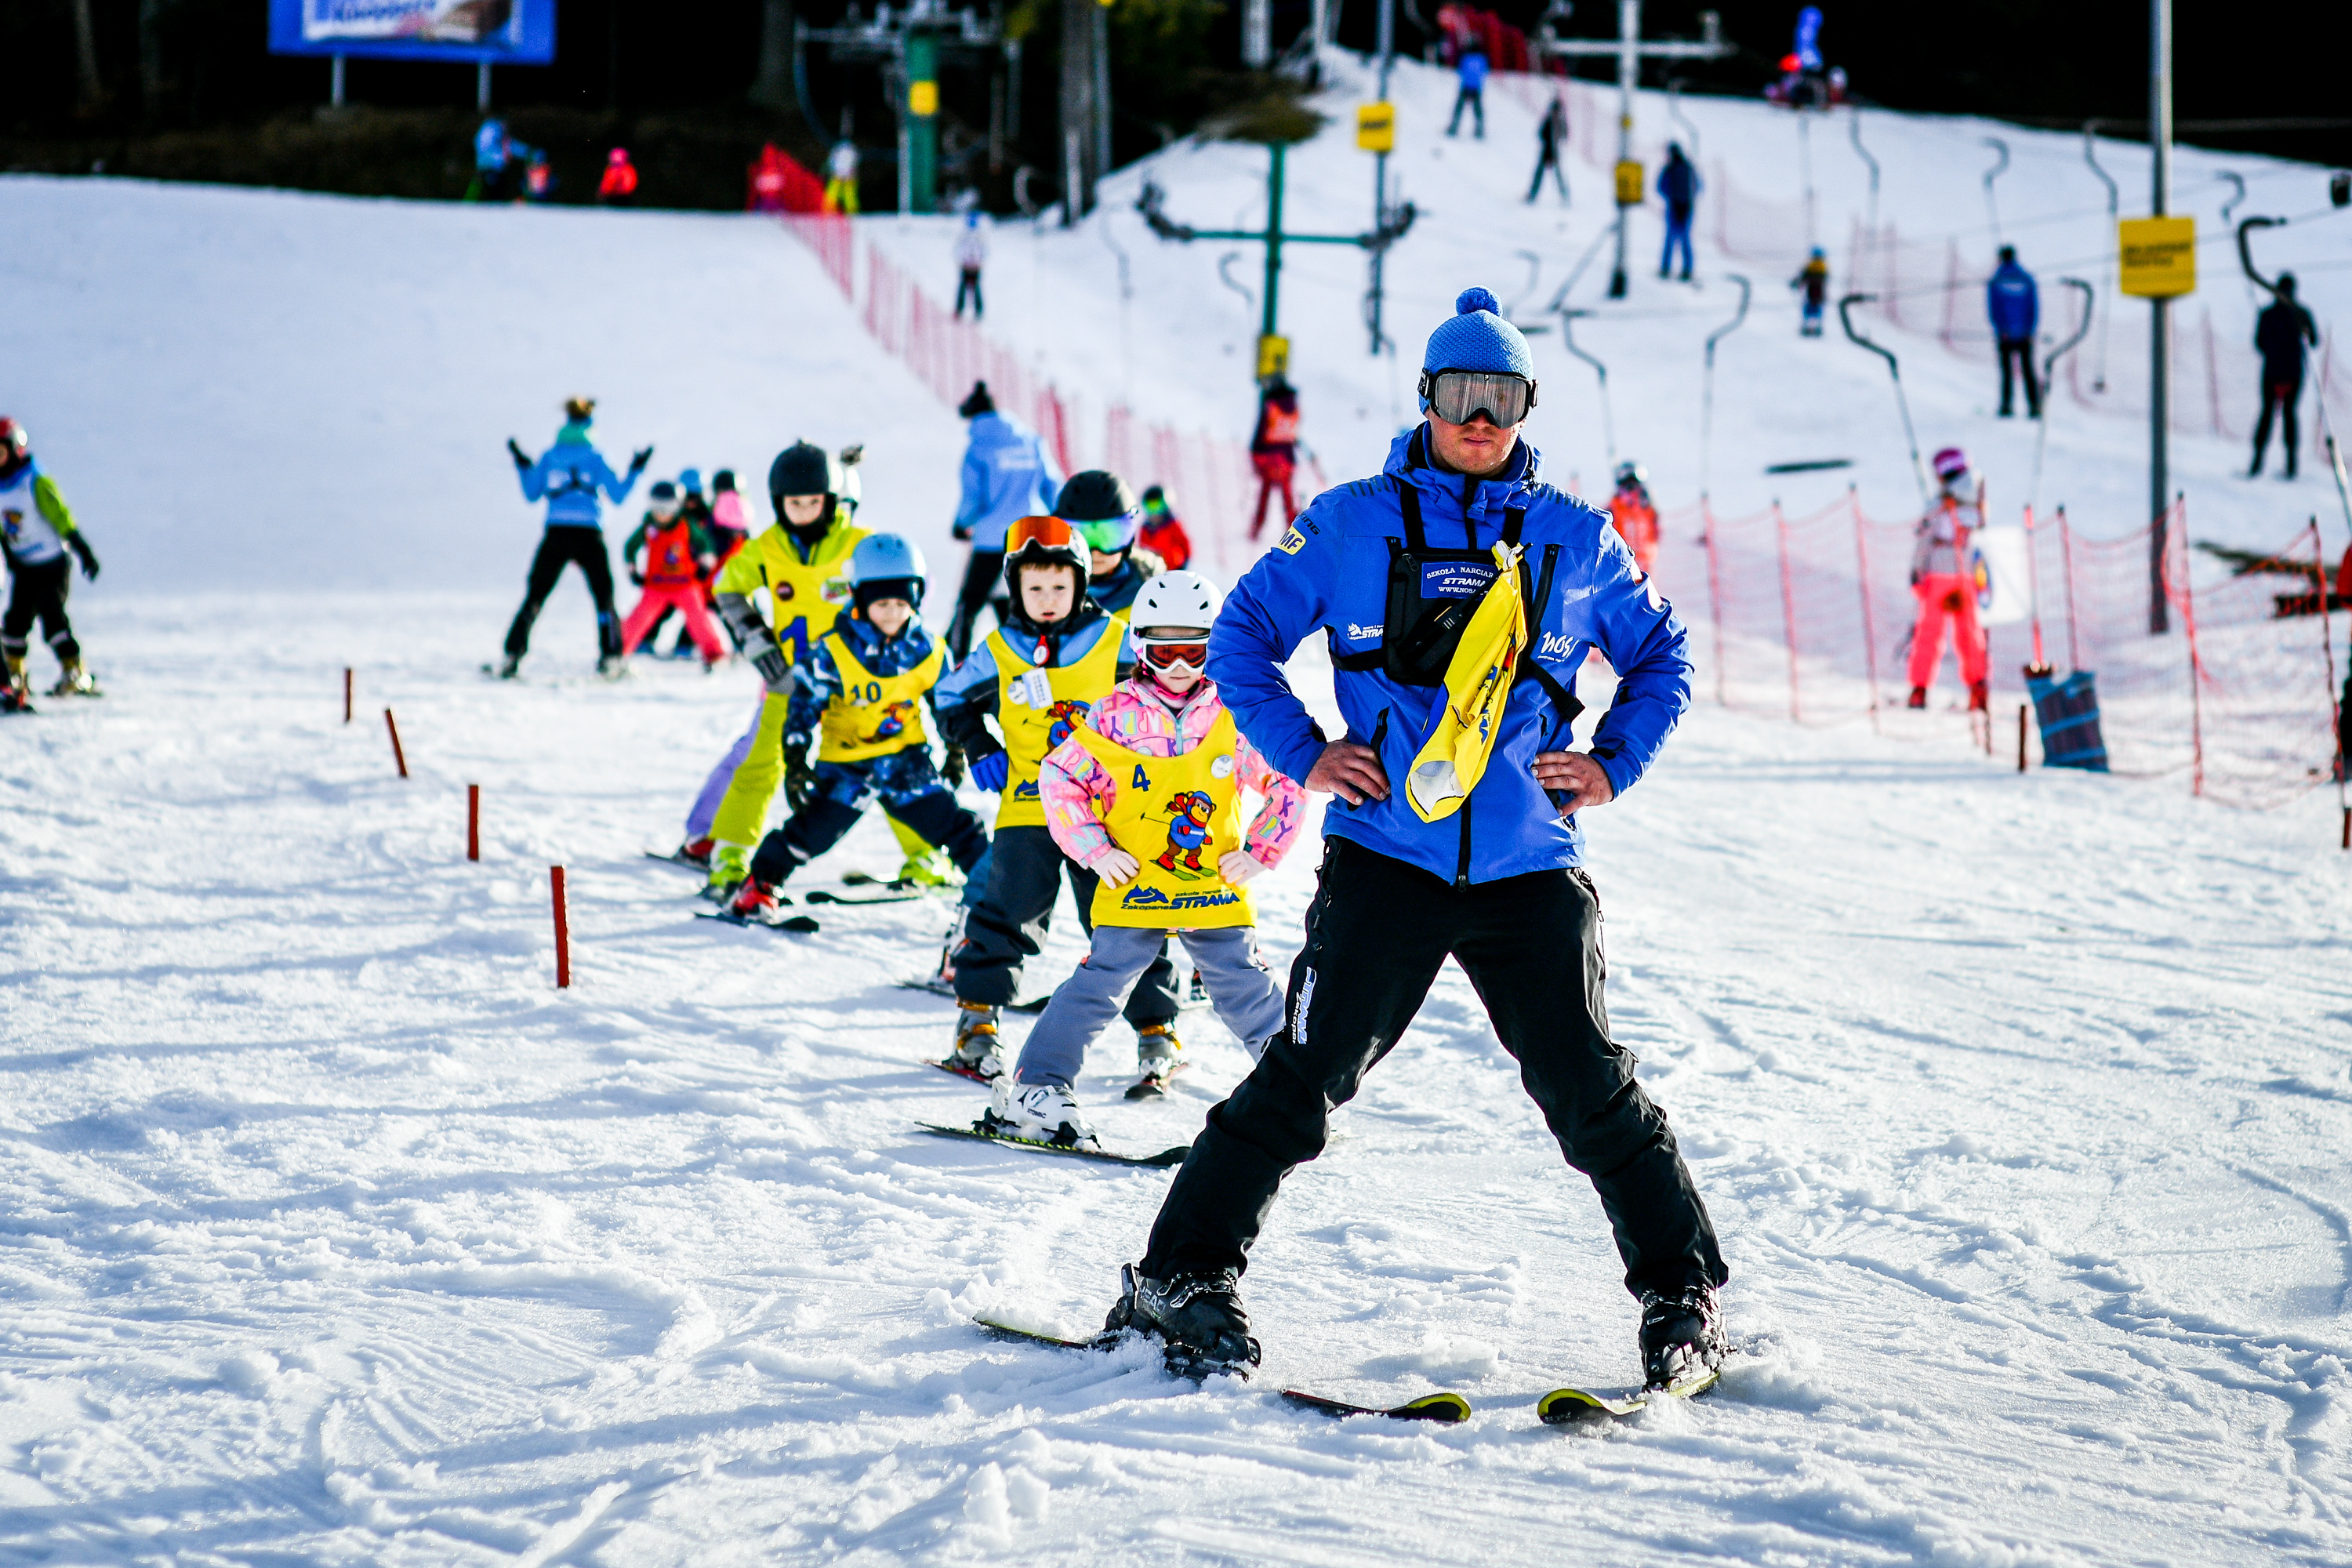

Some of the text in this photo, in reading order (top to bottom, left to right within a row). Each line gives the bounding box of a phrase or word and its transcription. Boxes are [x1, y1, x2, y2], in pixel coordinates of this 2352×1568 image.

[780, 616, 809, 665] 1
[851, 681, 882, 703] 10
[1132, 763, 1152, 793] 4
[1169, 892, 1241, 910] STRAMA
